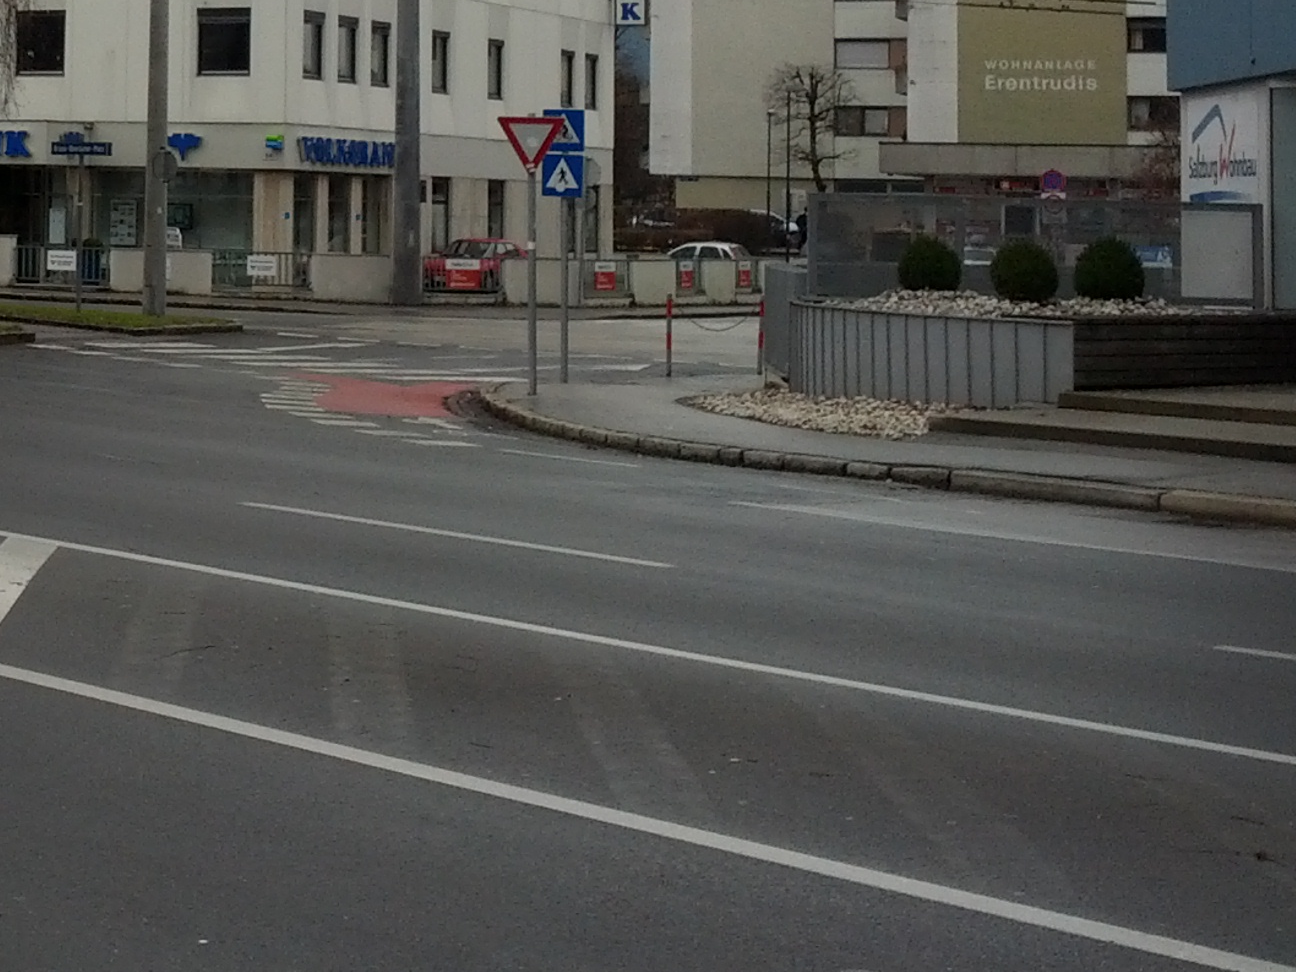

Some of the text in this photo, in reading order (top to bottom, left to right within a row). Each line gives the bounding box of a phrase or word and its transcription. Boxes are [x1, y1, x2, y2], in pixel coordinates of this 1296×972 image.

[984, 59, 1097, 70] WOHNANLAGE
[985, 74, 1098, 91] Erentrudis
[301, 136, 396, 168] VOLKSBAN
